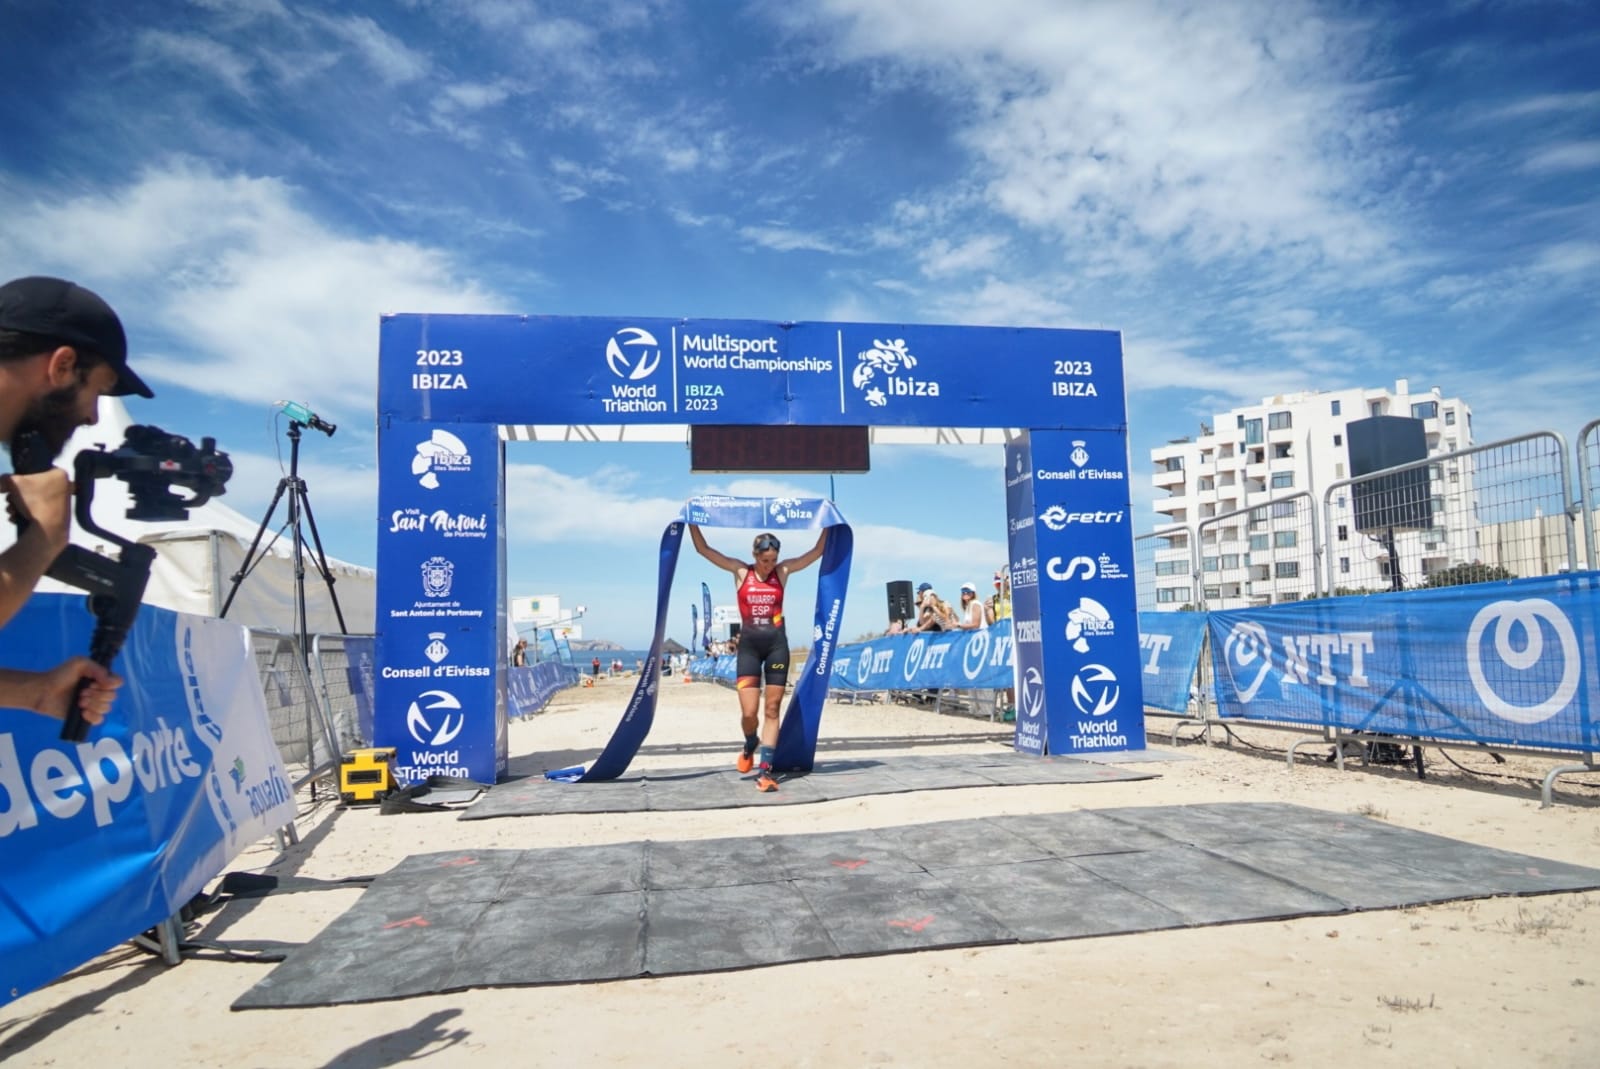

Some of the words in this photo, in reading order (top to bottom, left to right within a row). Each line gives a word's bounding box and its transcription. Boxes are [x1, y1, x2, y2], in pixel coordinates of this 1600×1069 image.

[683, 334, 778, 356] Multisport
[416, 350, 463, 366] 2023
[684, 355, 727, 369] World
[730, 355, 833, 373] Championships
[1054, 360, 1092, 376] 2023
[412, 373, 468, 389] IBIZA
[888, 376, 940, 397] Ibiza
[611, 384, 657, 398] World
[685, 385, 724, 396] IBIZA
[1052, 381, 1098, 397] IBIZA
[602, 398, 667, 412] Triathlon
[685, 398, 718, 411] 2023
[1037, 469, 1076, 480] Consell
[1078, 468, 1124, 480] d'Eivissa
[390, 510, 428, 532] Sant
[429, 510, 487, 532] Antoni
[787, 508, 813, 519] Ibiza
[414, 601, 451, 609] Ajuntament
[752, 605, 770, 616] ESP
[390, 610, 408, 618] Sant
[409, 609, 435, 617] Antoni
[436, 609, 445, 617] de
[446, 609, 483, 618] Portmany
[815, 640, 831, 676] Consell
[824, 598, 841, 641] d'Eivissa
[871, 649, 894, 674] NTT
[920, 643, 951, 670] NTT
[1281, 632, 1374, 687] NTT
[382, 666, 430, 678] Consell
[433, 665, 490, 678] d'Eivissa
[1022, 720, 1040, 736] World
[1077, 719, 1117, 734] World
[1070, 734, 1127, 749] Triathlon
[412, 750, 459, 765] World
